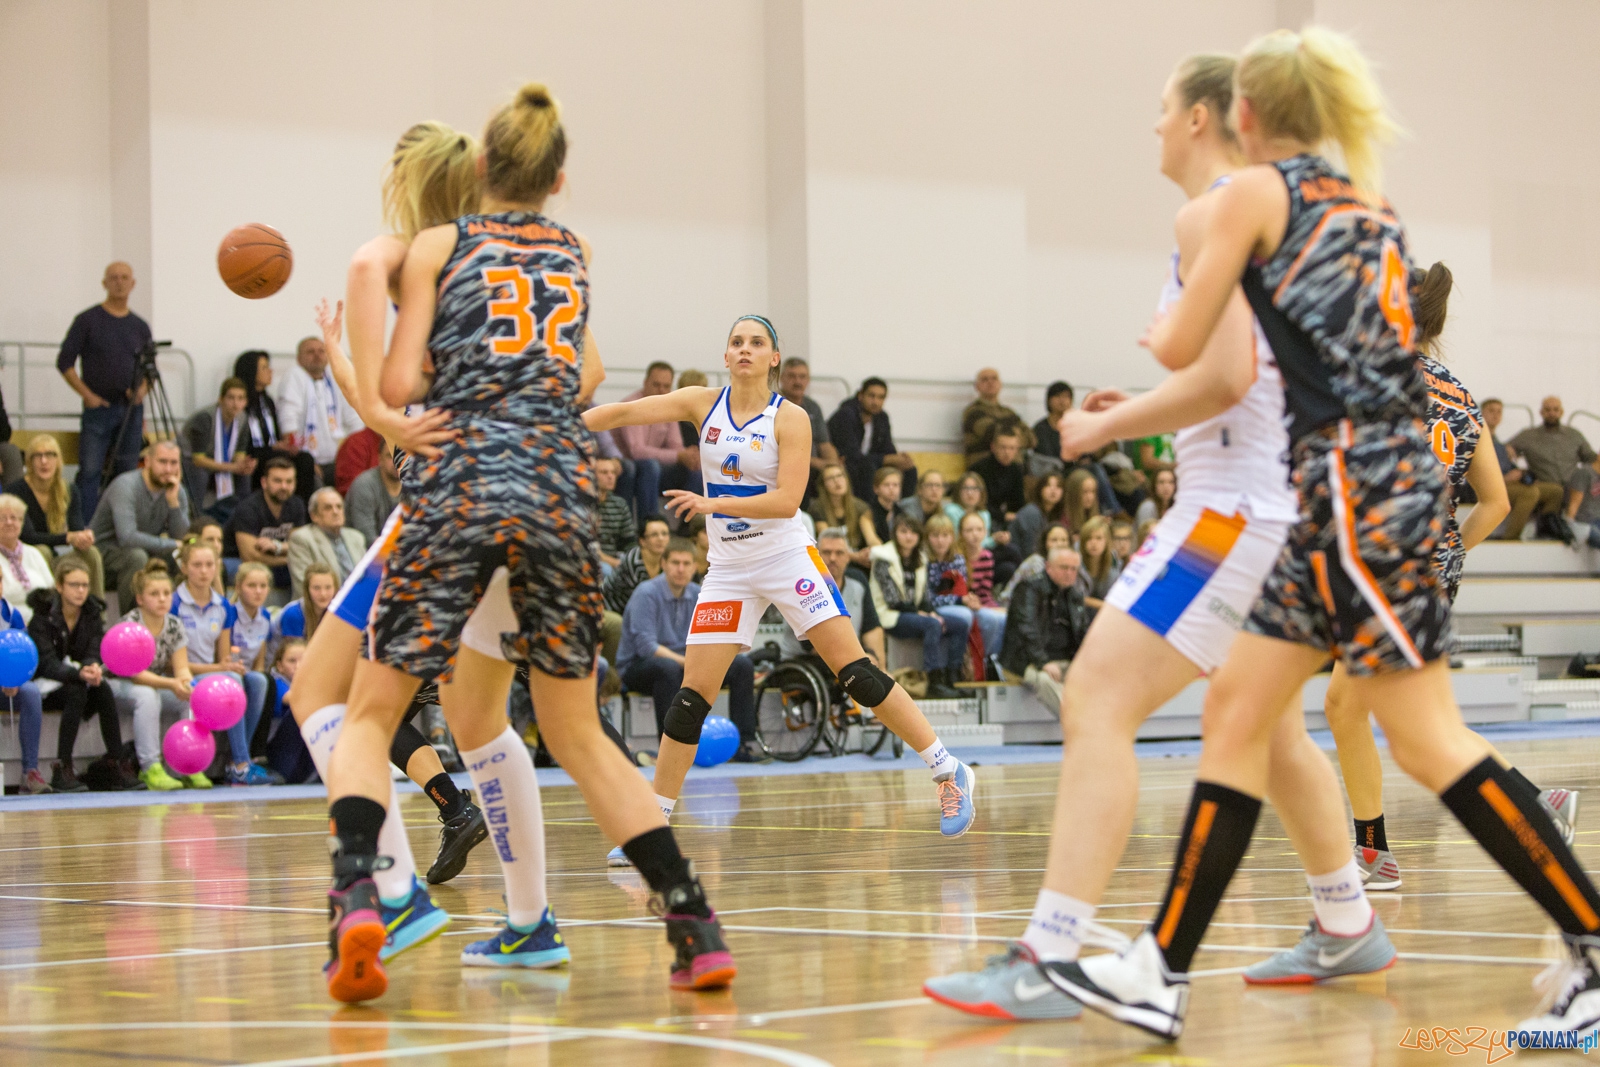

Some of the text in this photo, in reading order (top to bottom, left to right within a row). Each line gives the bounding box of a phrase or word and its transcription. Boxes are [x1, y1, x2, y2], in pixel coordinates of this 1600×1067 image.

[482, 264, 579, 368] 32
[721, 453, 744, 482] 4
[737, 531, 764, 541] Motors
[696, 612, 733, 623] SZPIKU
[430, 786, 449, 806] BASKET
